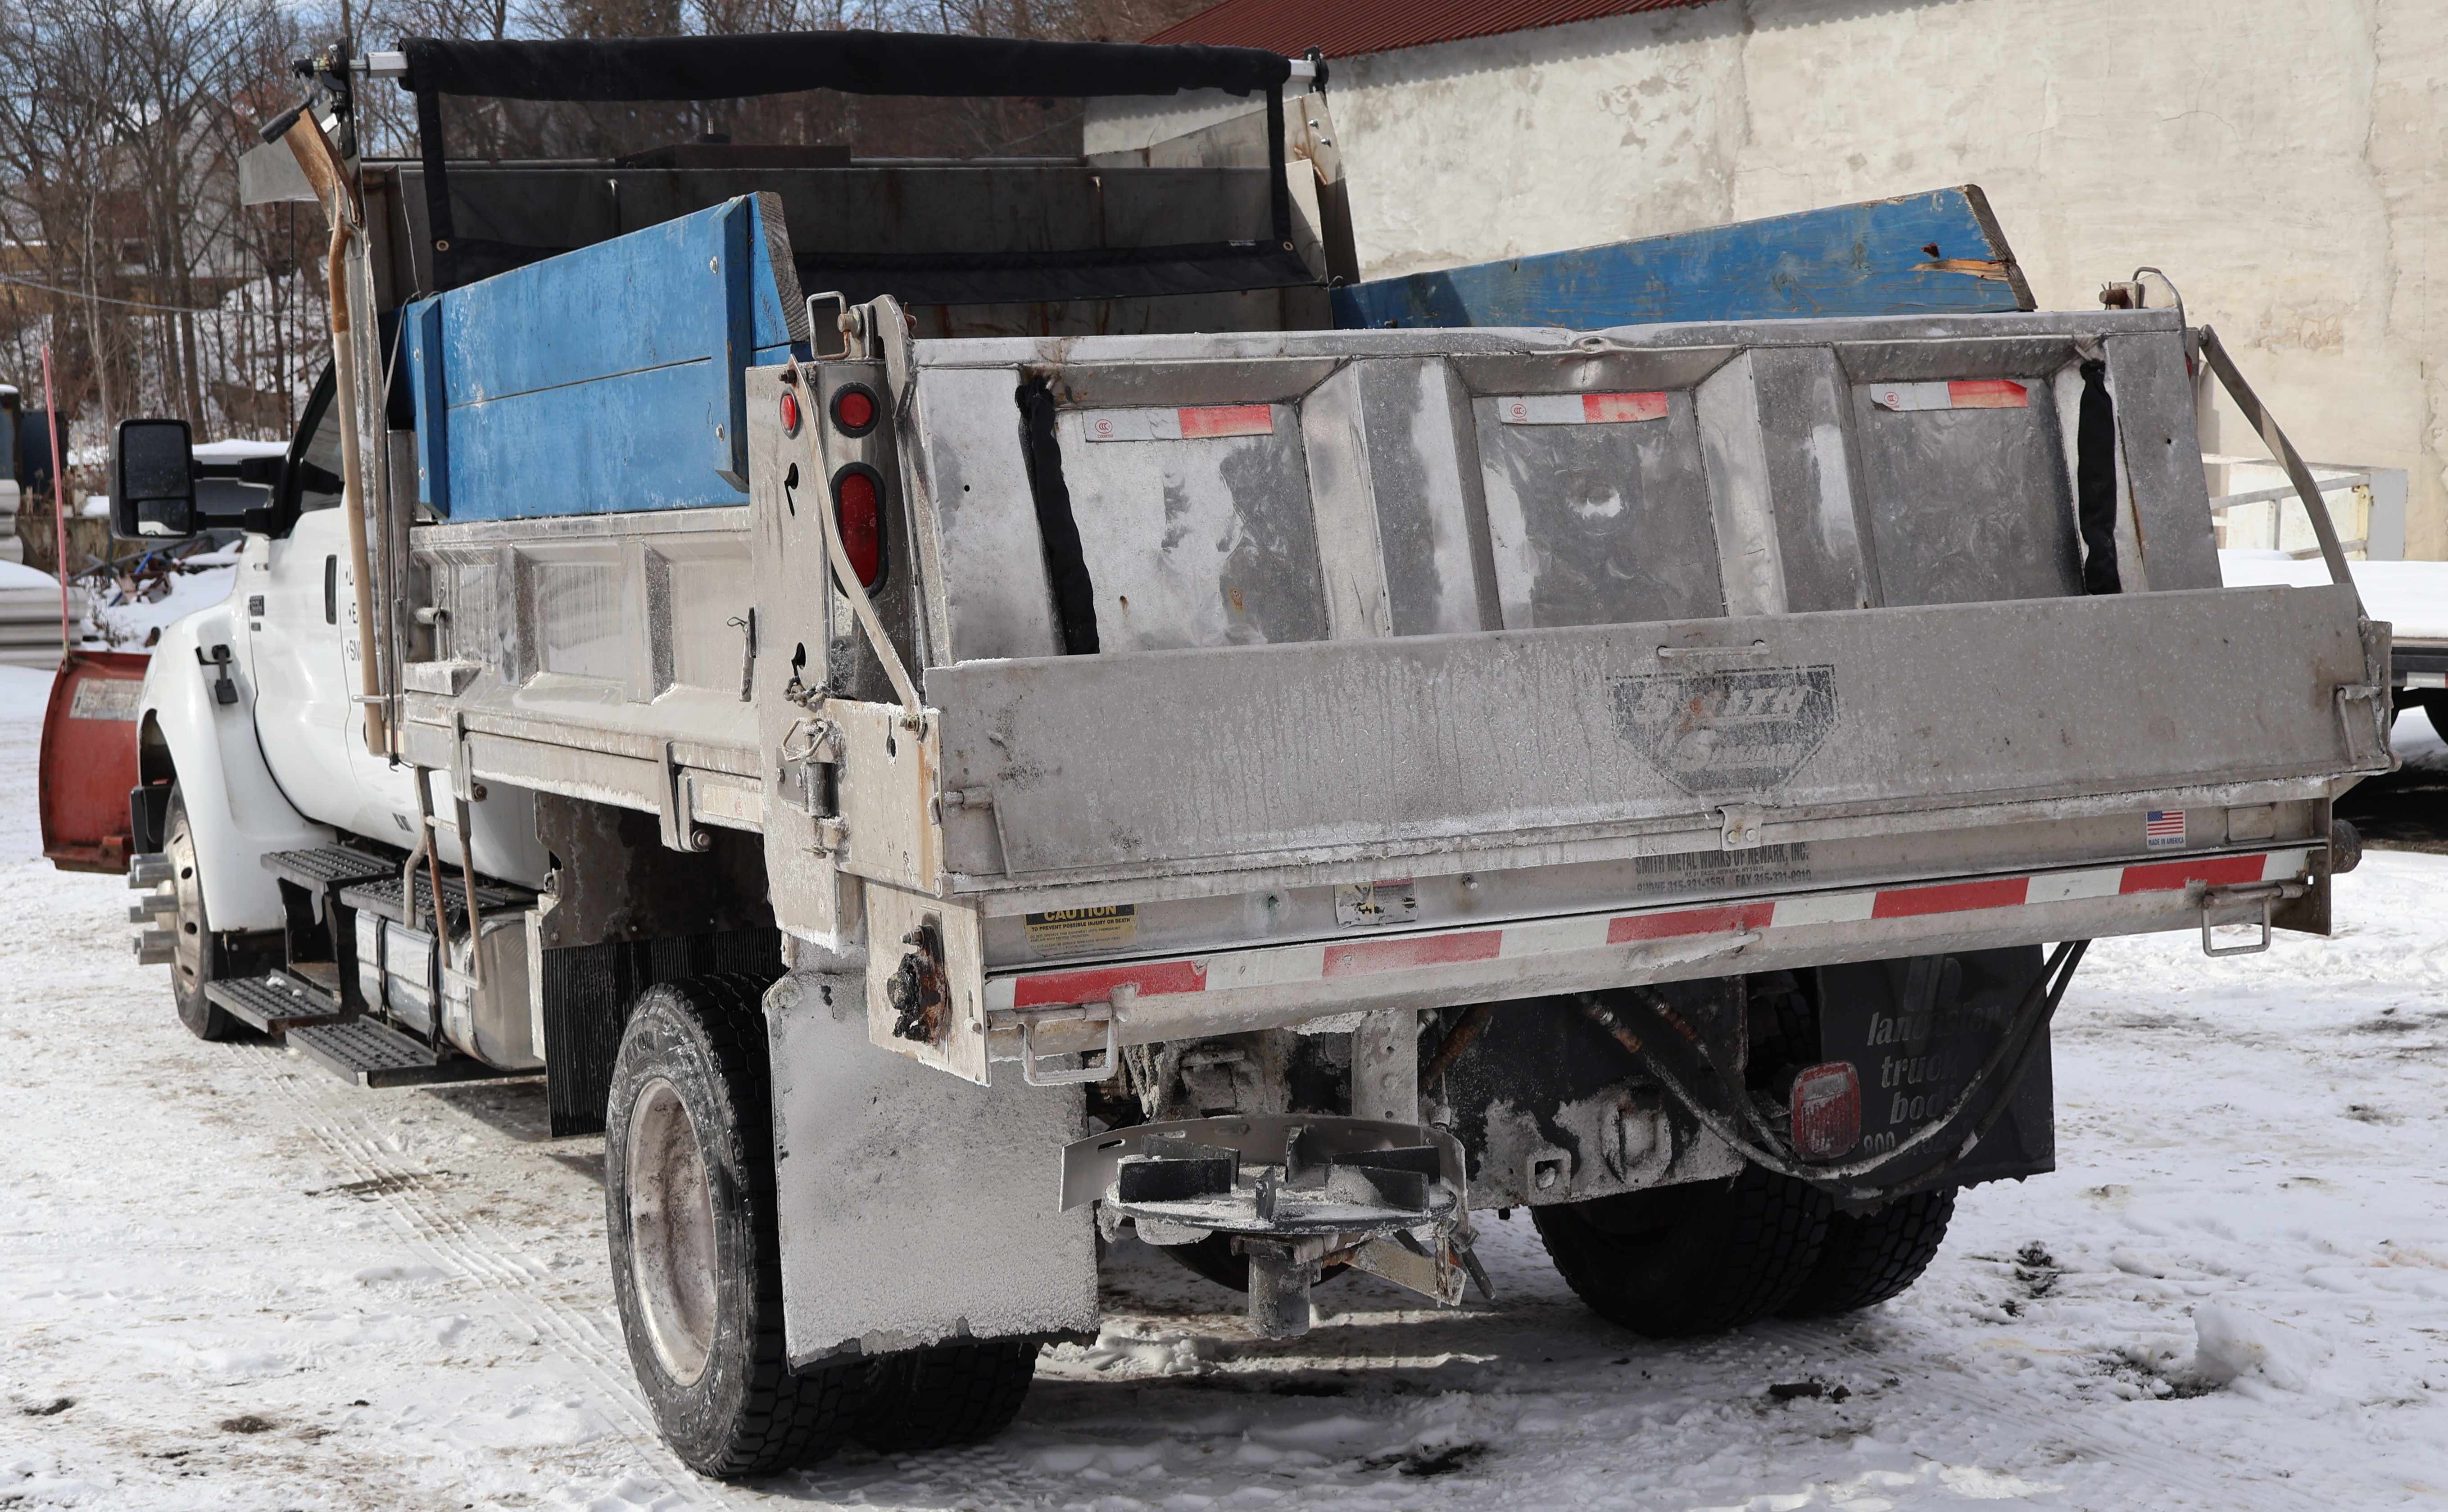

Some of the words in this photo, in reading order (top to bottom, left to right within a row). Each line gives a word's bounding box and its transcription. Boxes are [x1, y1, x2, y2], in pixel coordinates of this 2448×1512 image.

[1636, 855, 1664, 874] SMITH
[1668, 852, 1697, 872] METAL
[1700, 850, 1731, 869] WORKS
[1734, 849, 1745, 866] OF
[1736, 873, 1751, 887] FAX
[1044, 905, 1117, 921] CAUTION
[1867, 1003, 2001, 1046] lancaster
[1881, 1049, 1961, 1088] truck
